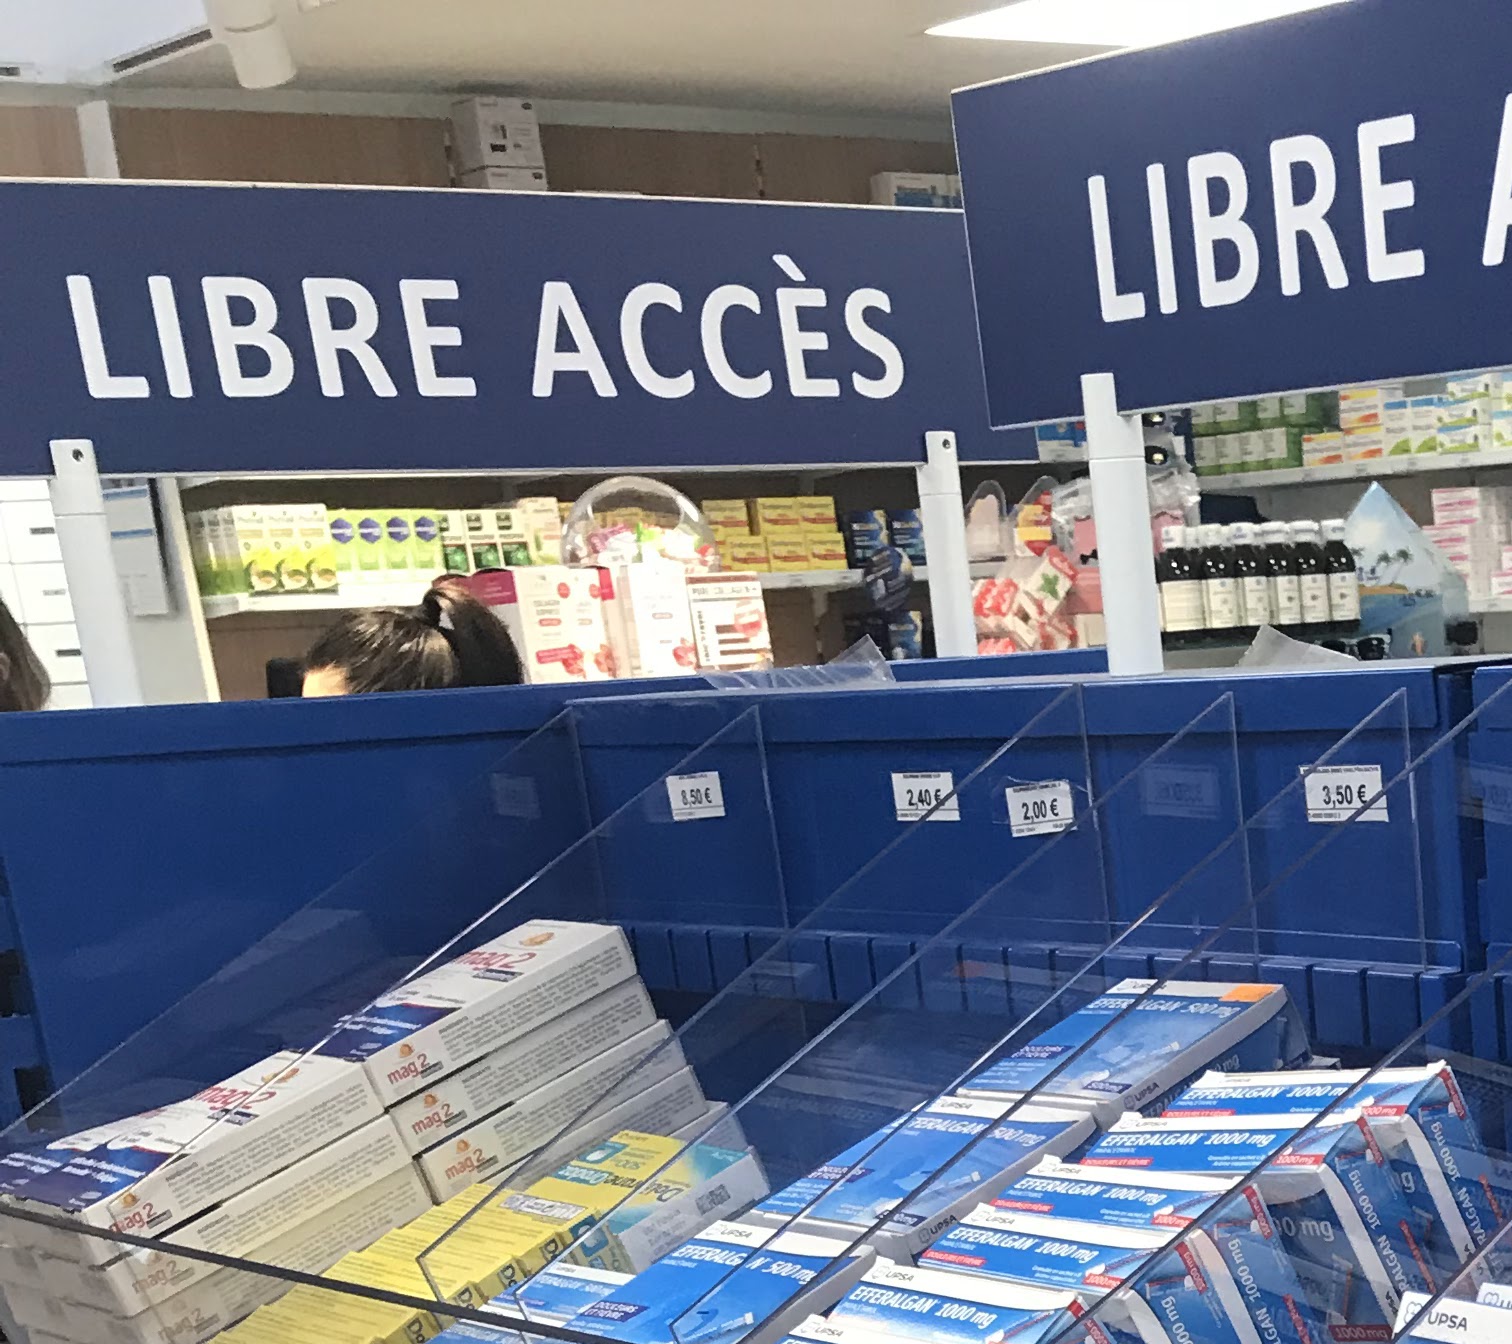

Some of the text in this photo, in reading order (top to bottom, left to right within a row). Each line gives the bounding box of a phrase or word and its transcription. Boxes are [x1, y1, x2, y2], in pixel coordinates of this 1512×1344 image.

[1087, 113, 1426, 324] LIBRE
[66, 254, 905, 400] LIBRE ACCÈS
[907, 789, 932, 810] 2,40
[1022, 799, 1059, 823] 2,00 €
[1322, 784, 1367, 808] 3,50 €
[387, 1053, 430, 1084] mag 2
[1183, 1084, 1329, 1100] EFFERALGAN 1000
[412, 1104, 454, 1135] mag 2
[1100, 1133, 1277, 1148] EFFERALGAN 1000 mg
[445, 1149, 486, 1179] mag 2
[849, 1286, 998, 1329] EFFERALGAN 1000 mg
